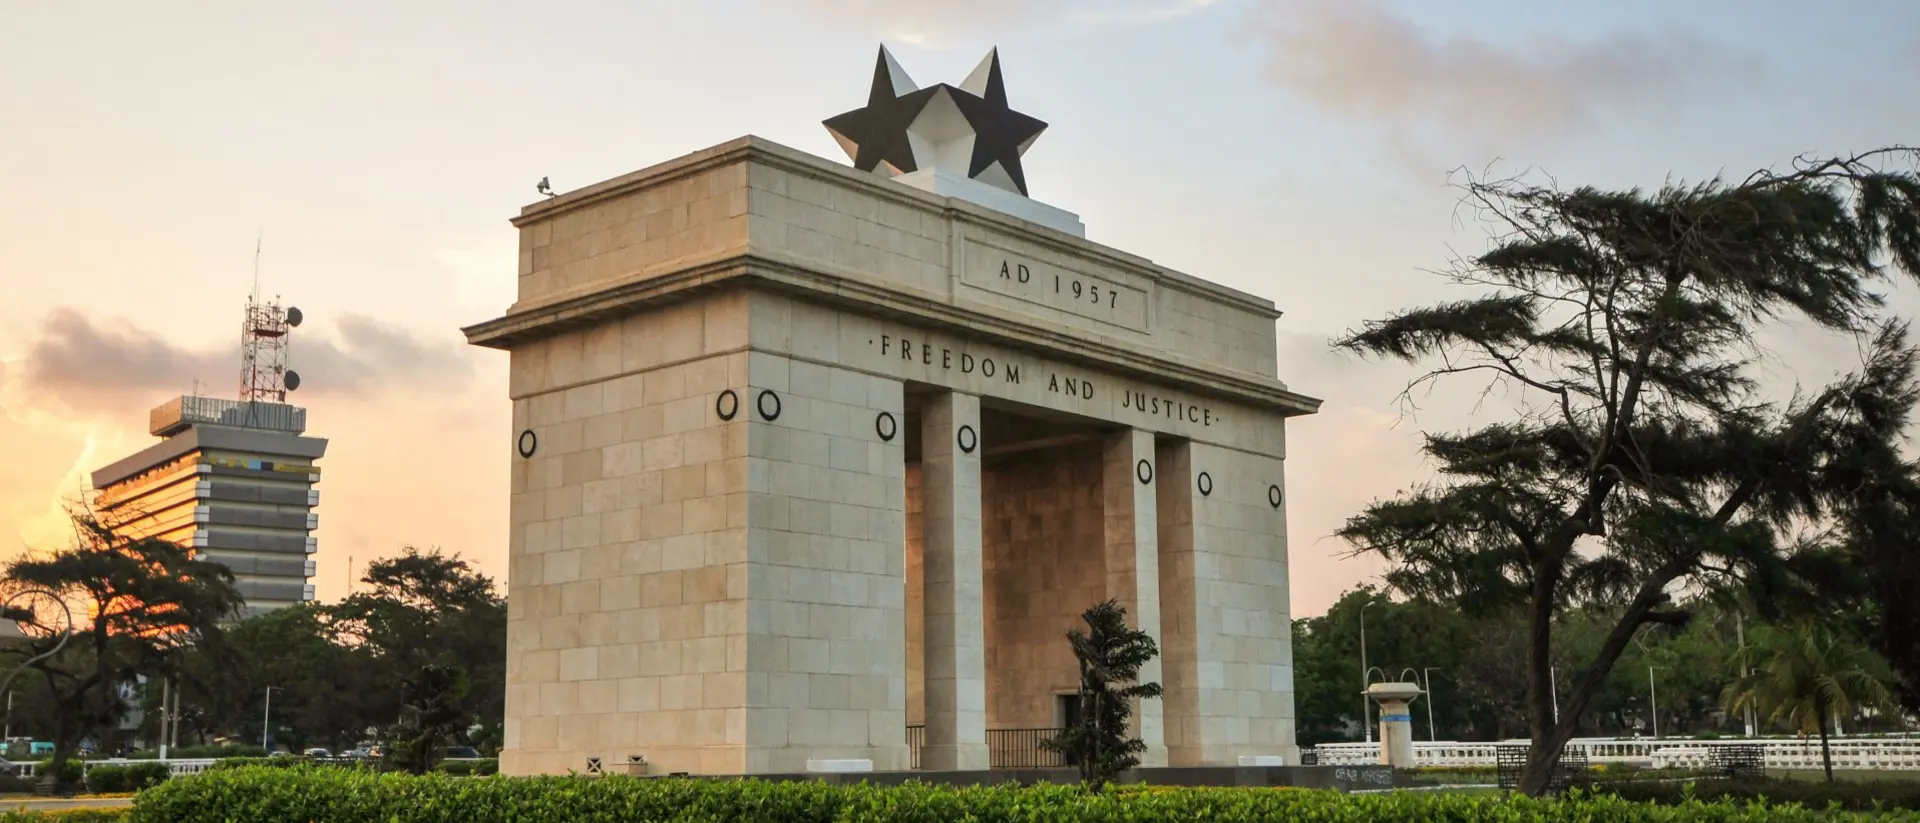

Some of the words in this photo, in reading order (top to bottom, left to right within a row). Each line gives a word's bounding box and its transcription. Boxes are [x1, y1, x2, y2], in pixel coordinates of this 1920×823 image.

[1000, 260, 1030, 283] AD
[1055, 275, 1117, 309] 1957
[1048, 373, 1094, 400] AND
